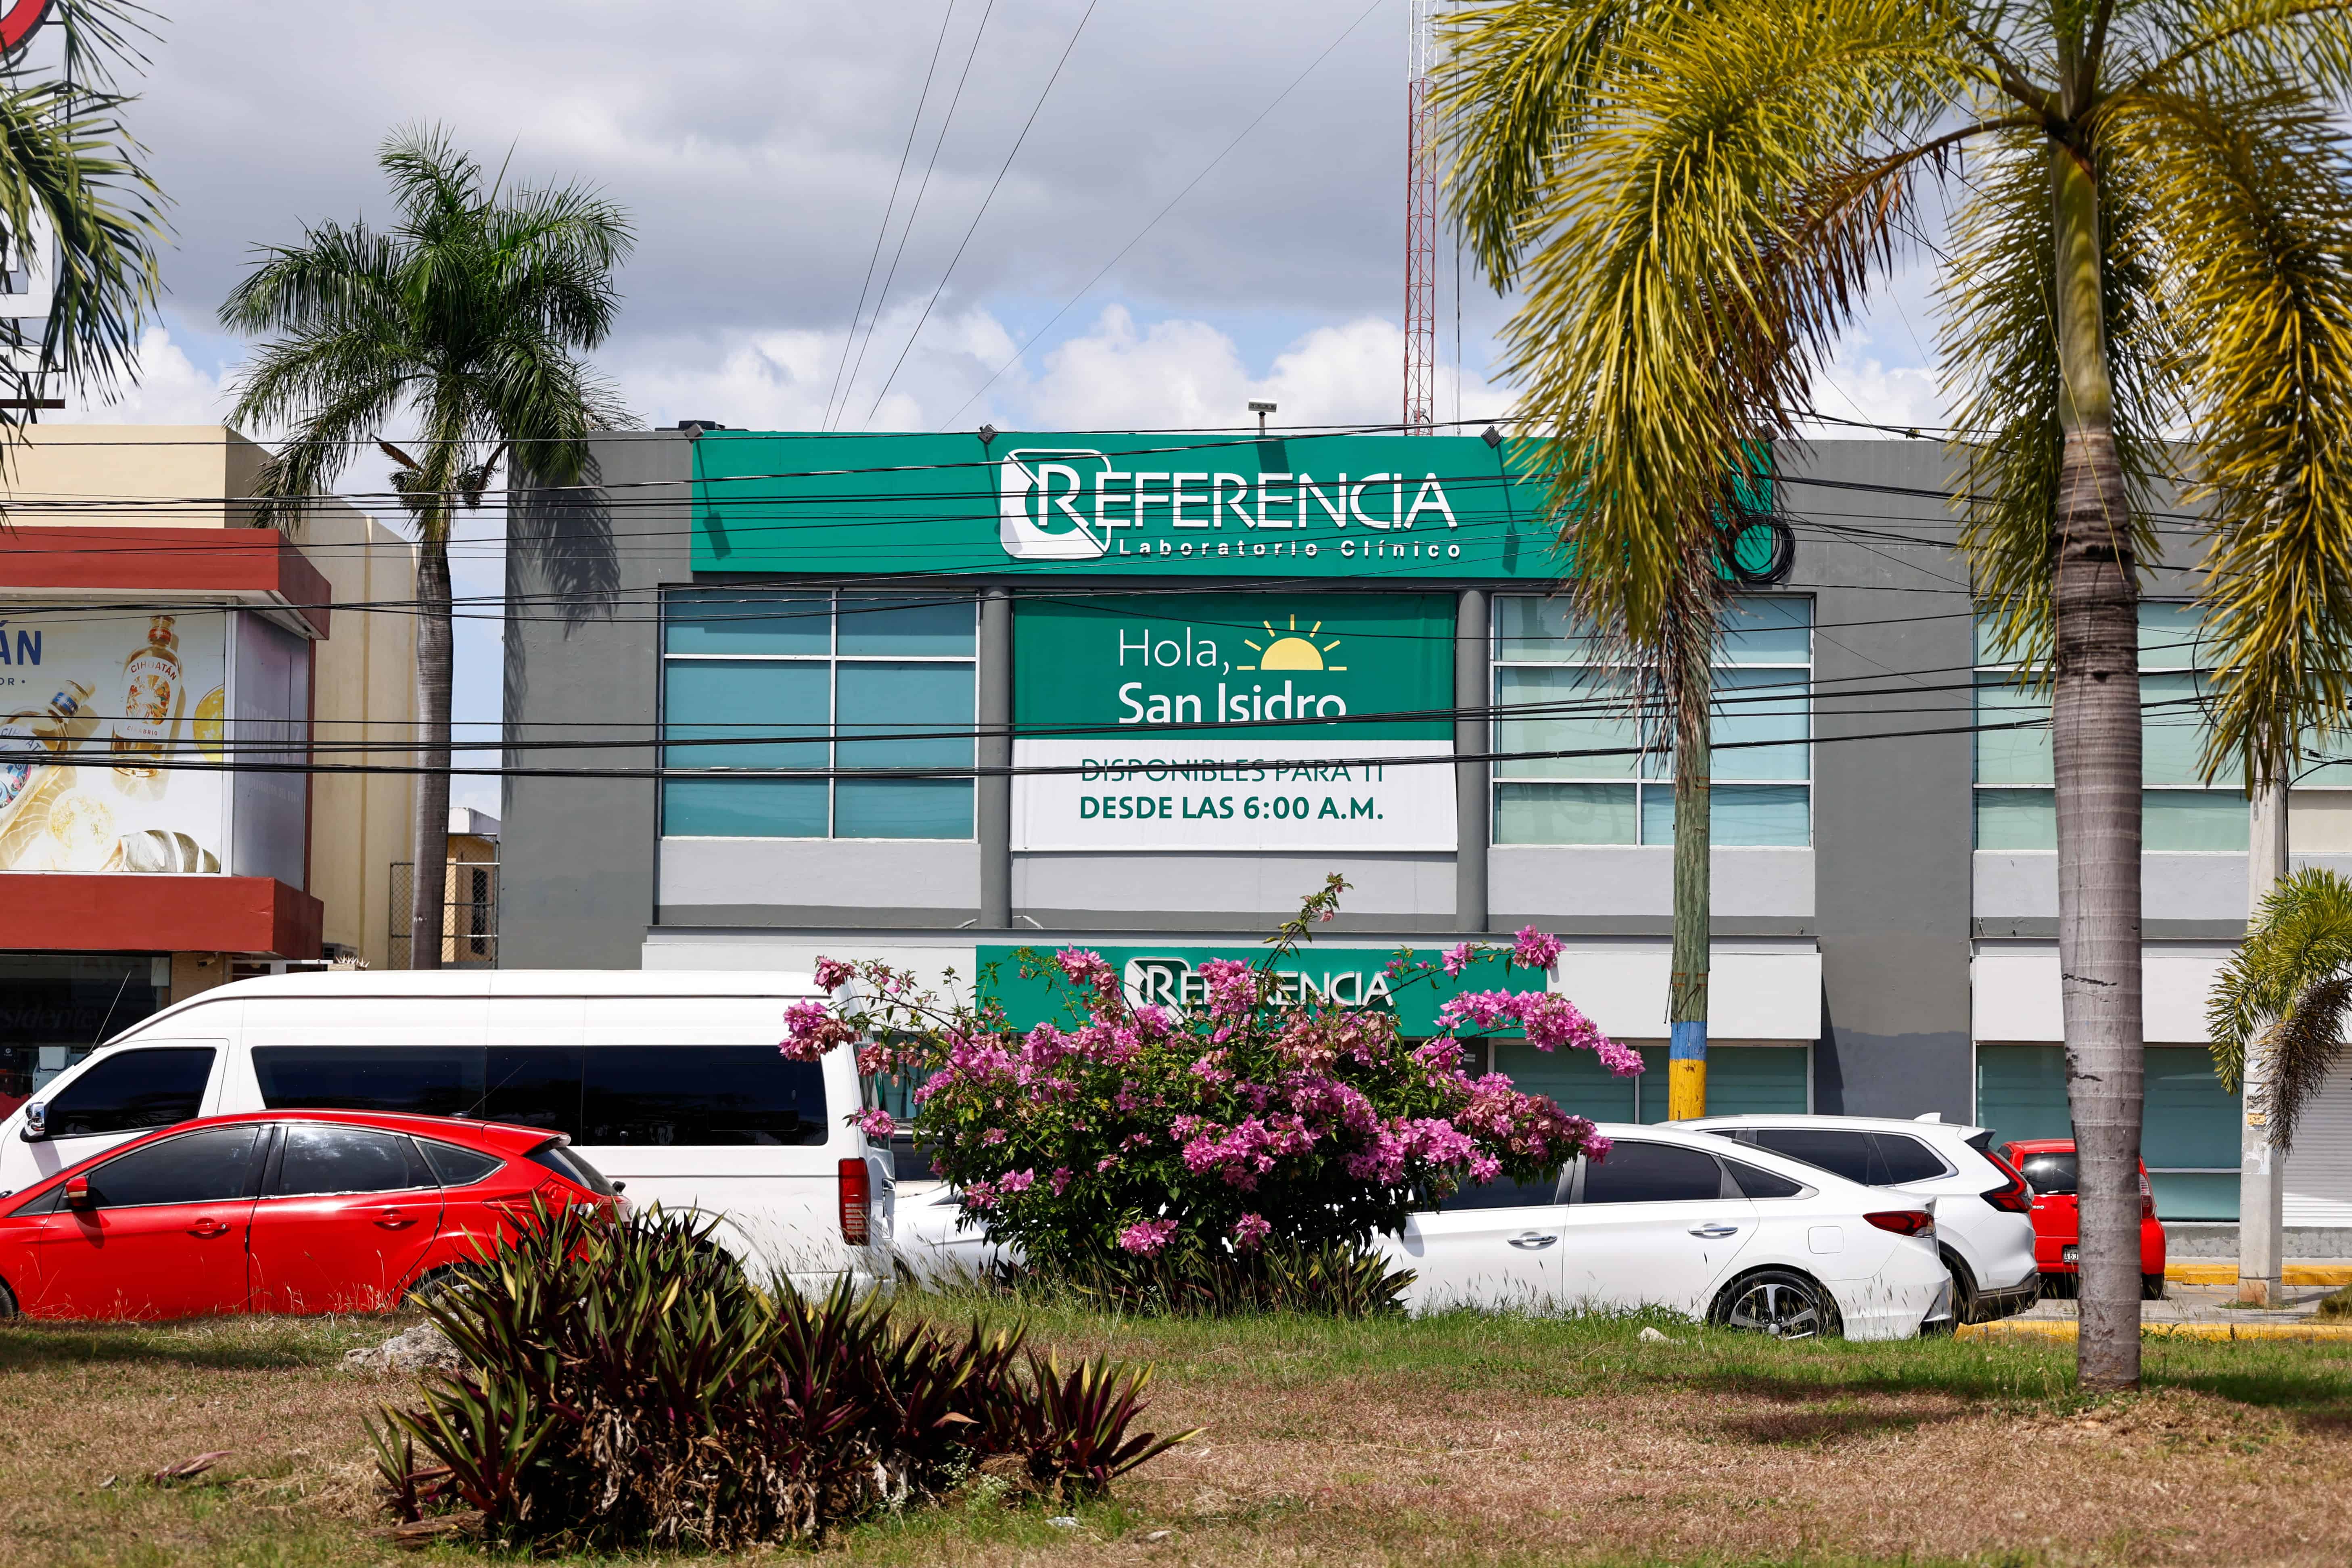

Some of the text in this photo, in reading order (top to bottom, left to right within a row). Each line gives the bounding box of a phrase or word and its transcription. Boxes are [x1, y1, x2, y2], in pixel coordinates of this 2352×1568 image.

[1038, 464, 1458, 529] REFERENCIA
[1119, 539, 1461, 558] Laboratorio Clínico
[1119, 627, 1229, 675] Hola,
[1119, 680, 1346, 724] San Isidro
[1082, 759, 1265, 782] DISPONIBLES
[1275, 759, 1351, 782] PARA
[1080, 796, 1383, 820] DESDE LAS 6:00 A.M.
[1147, 965, 1394, 1006] REENCIA
